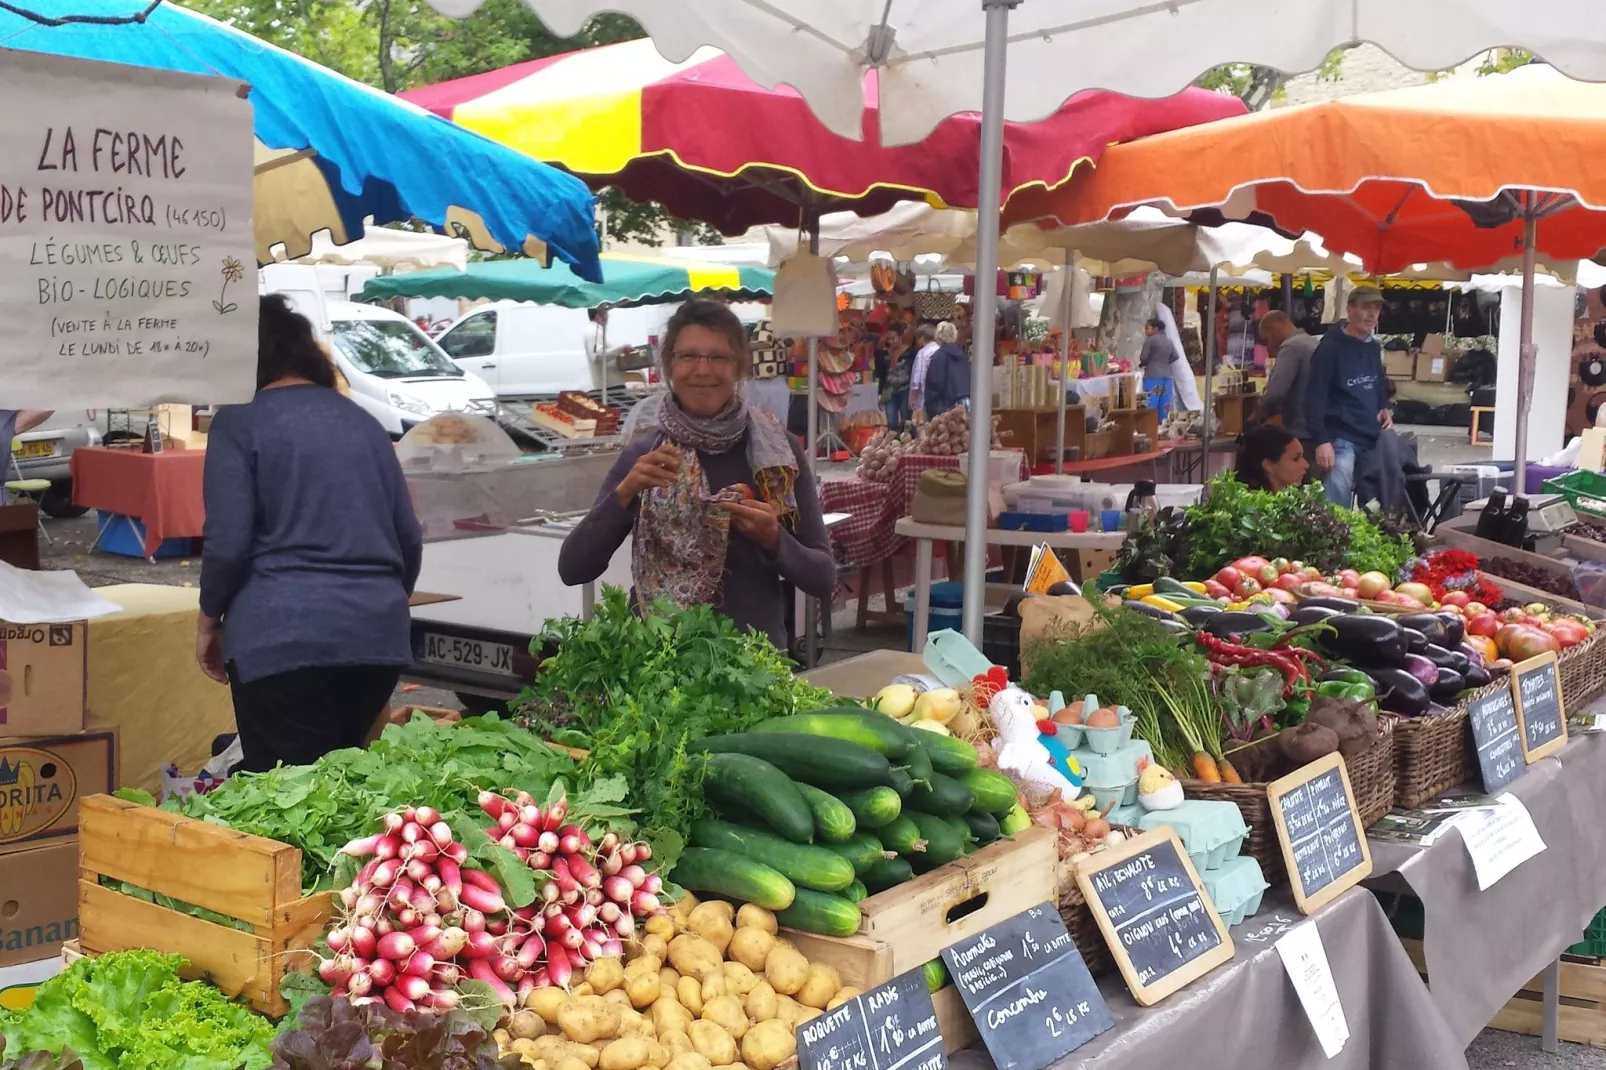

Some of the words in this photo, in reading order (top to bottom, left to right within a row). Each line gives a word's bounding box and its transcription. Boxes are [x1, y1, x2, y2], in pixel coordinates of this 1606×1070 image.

[38, 127, 77, 171] LA
[93, 129, 186, 178] FERME
[0, 184, 28, 223] DE
[30, 237, 124, 265] LÉGUMES
[132, 241, 144, 264] &
[51, 316, 97, 338] (VENTE
[117, 319, 132, 331] LA
[138, 317, 178, 330] FERME
[59, 343, 76, 356] LE
[127, 341, 144, 355] DE
[1157, 880, 1168, 893] LE
[802, 1005, 851, 1047] ROQUETTE
